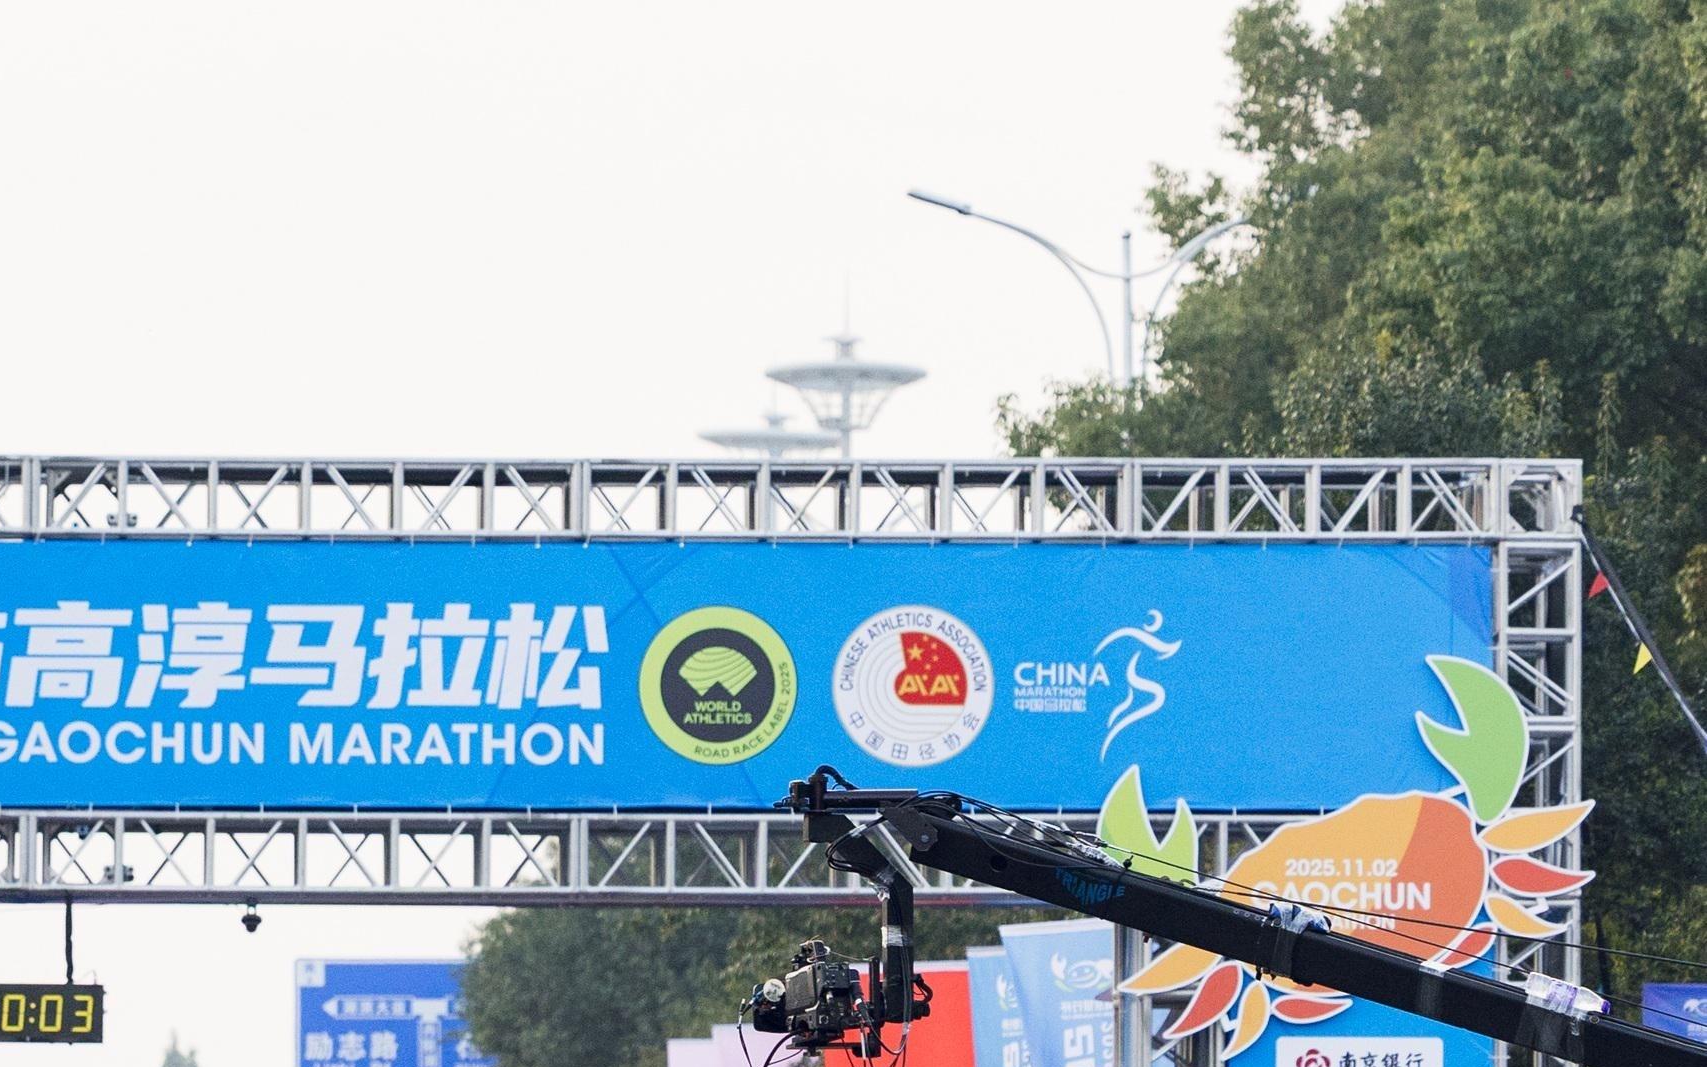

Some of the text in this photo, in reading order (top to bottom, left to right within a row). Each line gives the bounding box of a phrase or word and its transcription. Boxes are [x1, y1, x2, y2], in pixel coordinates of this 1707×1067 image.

[839, 612, 988, 693] CHINESE ATHLETICS ASSOCIATION
[1014, 661, 1109, 686] CHINA
[1015, 687, 1087, 698] MARATHON
[693, 661, 791, 759] ROAD RACE LABEL 2025
[695, 701, 742, 713] WORLD
[683, 712, 753, 725] ATHLETICS
[290, 723, 604, 766] MARATHON
[1285, 859, 1398, 876] 2025.11.02
